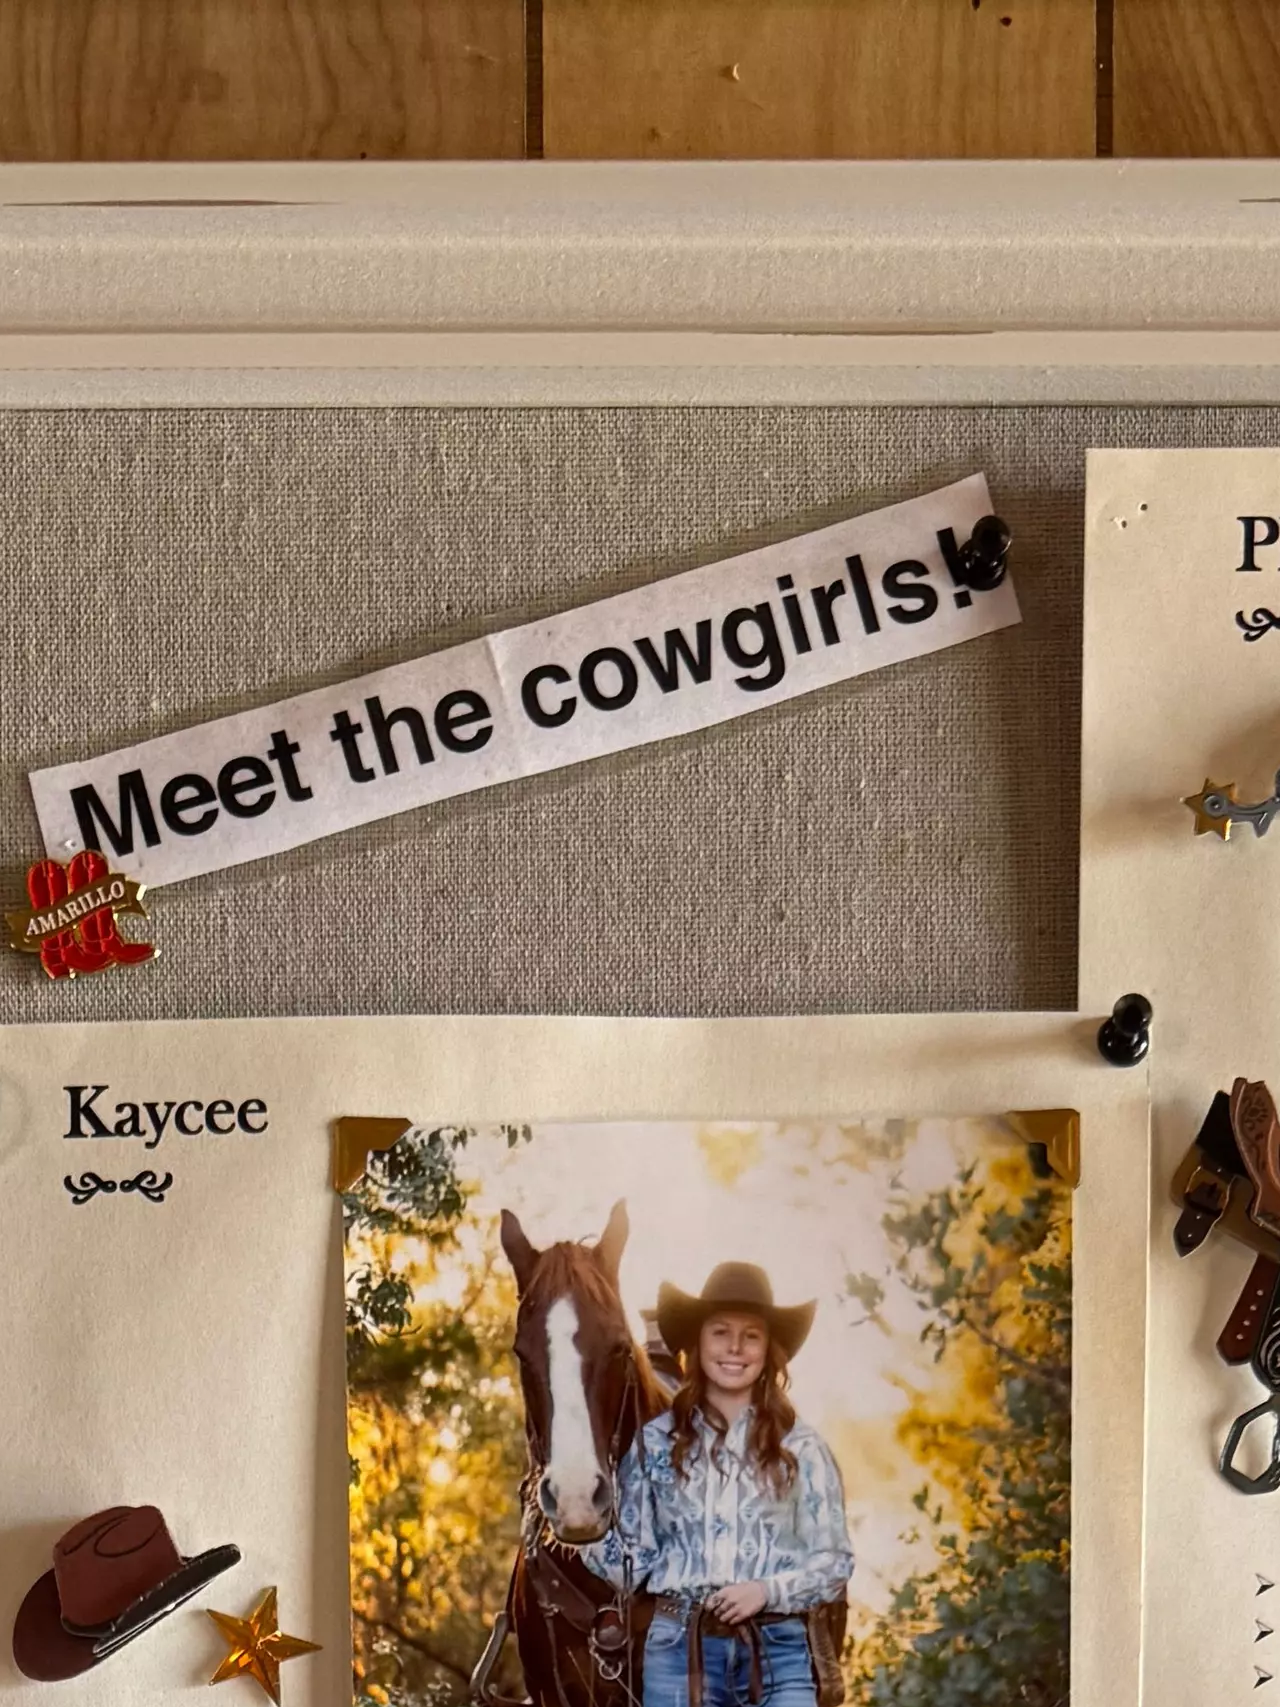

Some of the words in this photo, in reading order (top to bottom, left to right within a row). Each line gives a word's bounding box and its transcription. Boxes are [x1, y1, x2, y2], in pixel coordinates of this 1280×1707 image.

[69, 730, 313, 858] Meet
[327, 687, 494, 785] the
[520, 527, 973, 729] cowgirls!
[26, 880, 125, 936] AMARILLO
[63, 1085, 268, 1152] Kaycee
